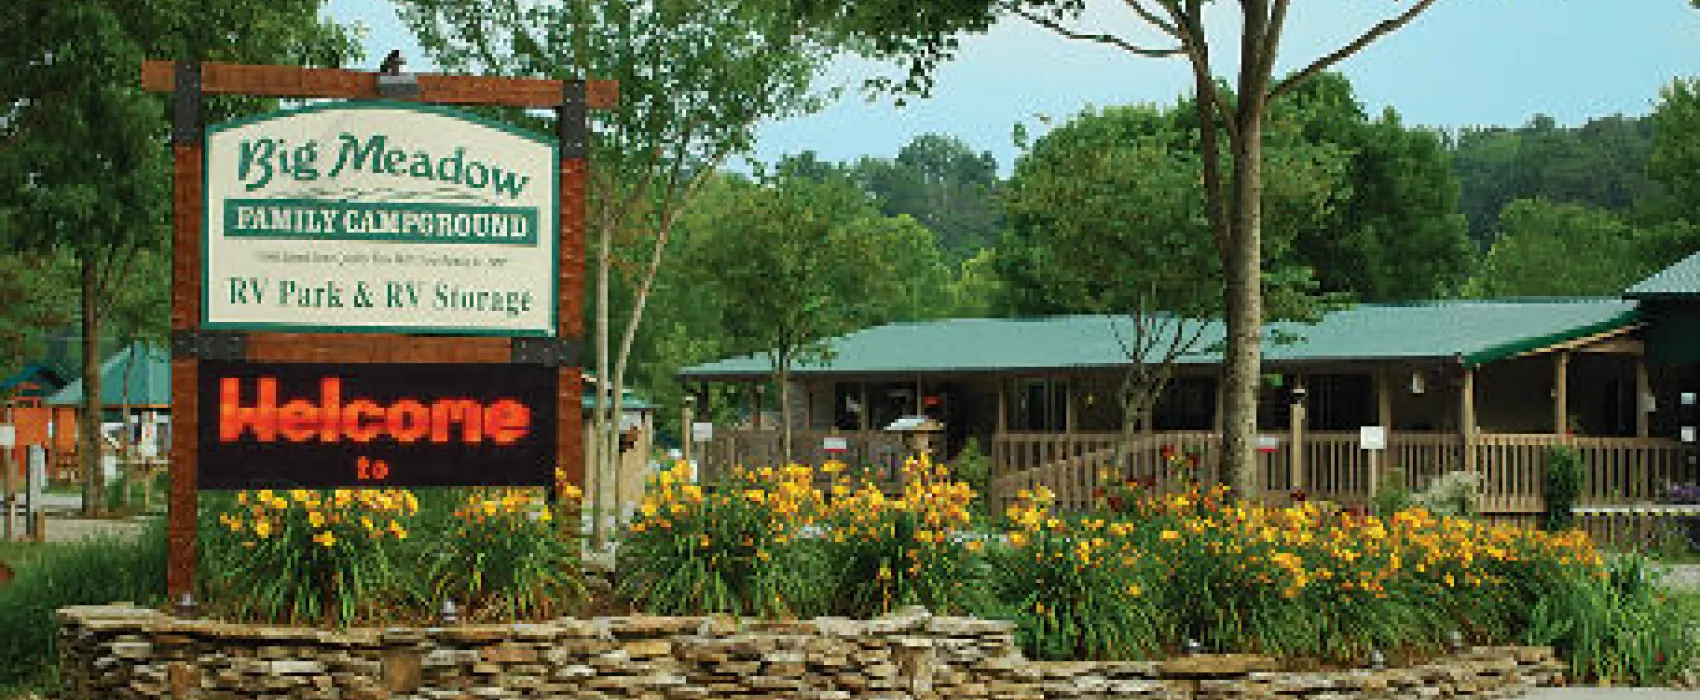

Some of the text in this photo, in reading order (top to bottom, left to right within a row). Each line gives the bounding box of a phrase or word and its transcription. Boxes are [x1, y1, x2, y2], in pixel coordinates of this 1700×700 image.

[238, 131, 530, 199] Big Meadow
[236, 205, 528, 238] FAMILY CAMPGROUND
[227, 277, 534, 317] RV Park & RV Storage
[219, 376, 531, 443] Welcome
[356, 455, 389, 480] to
